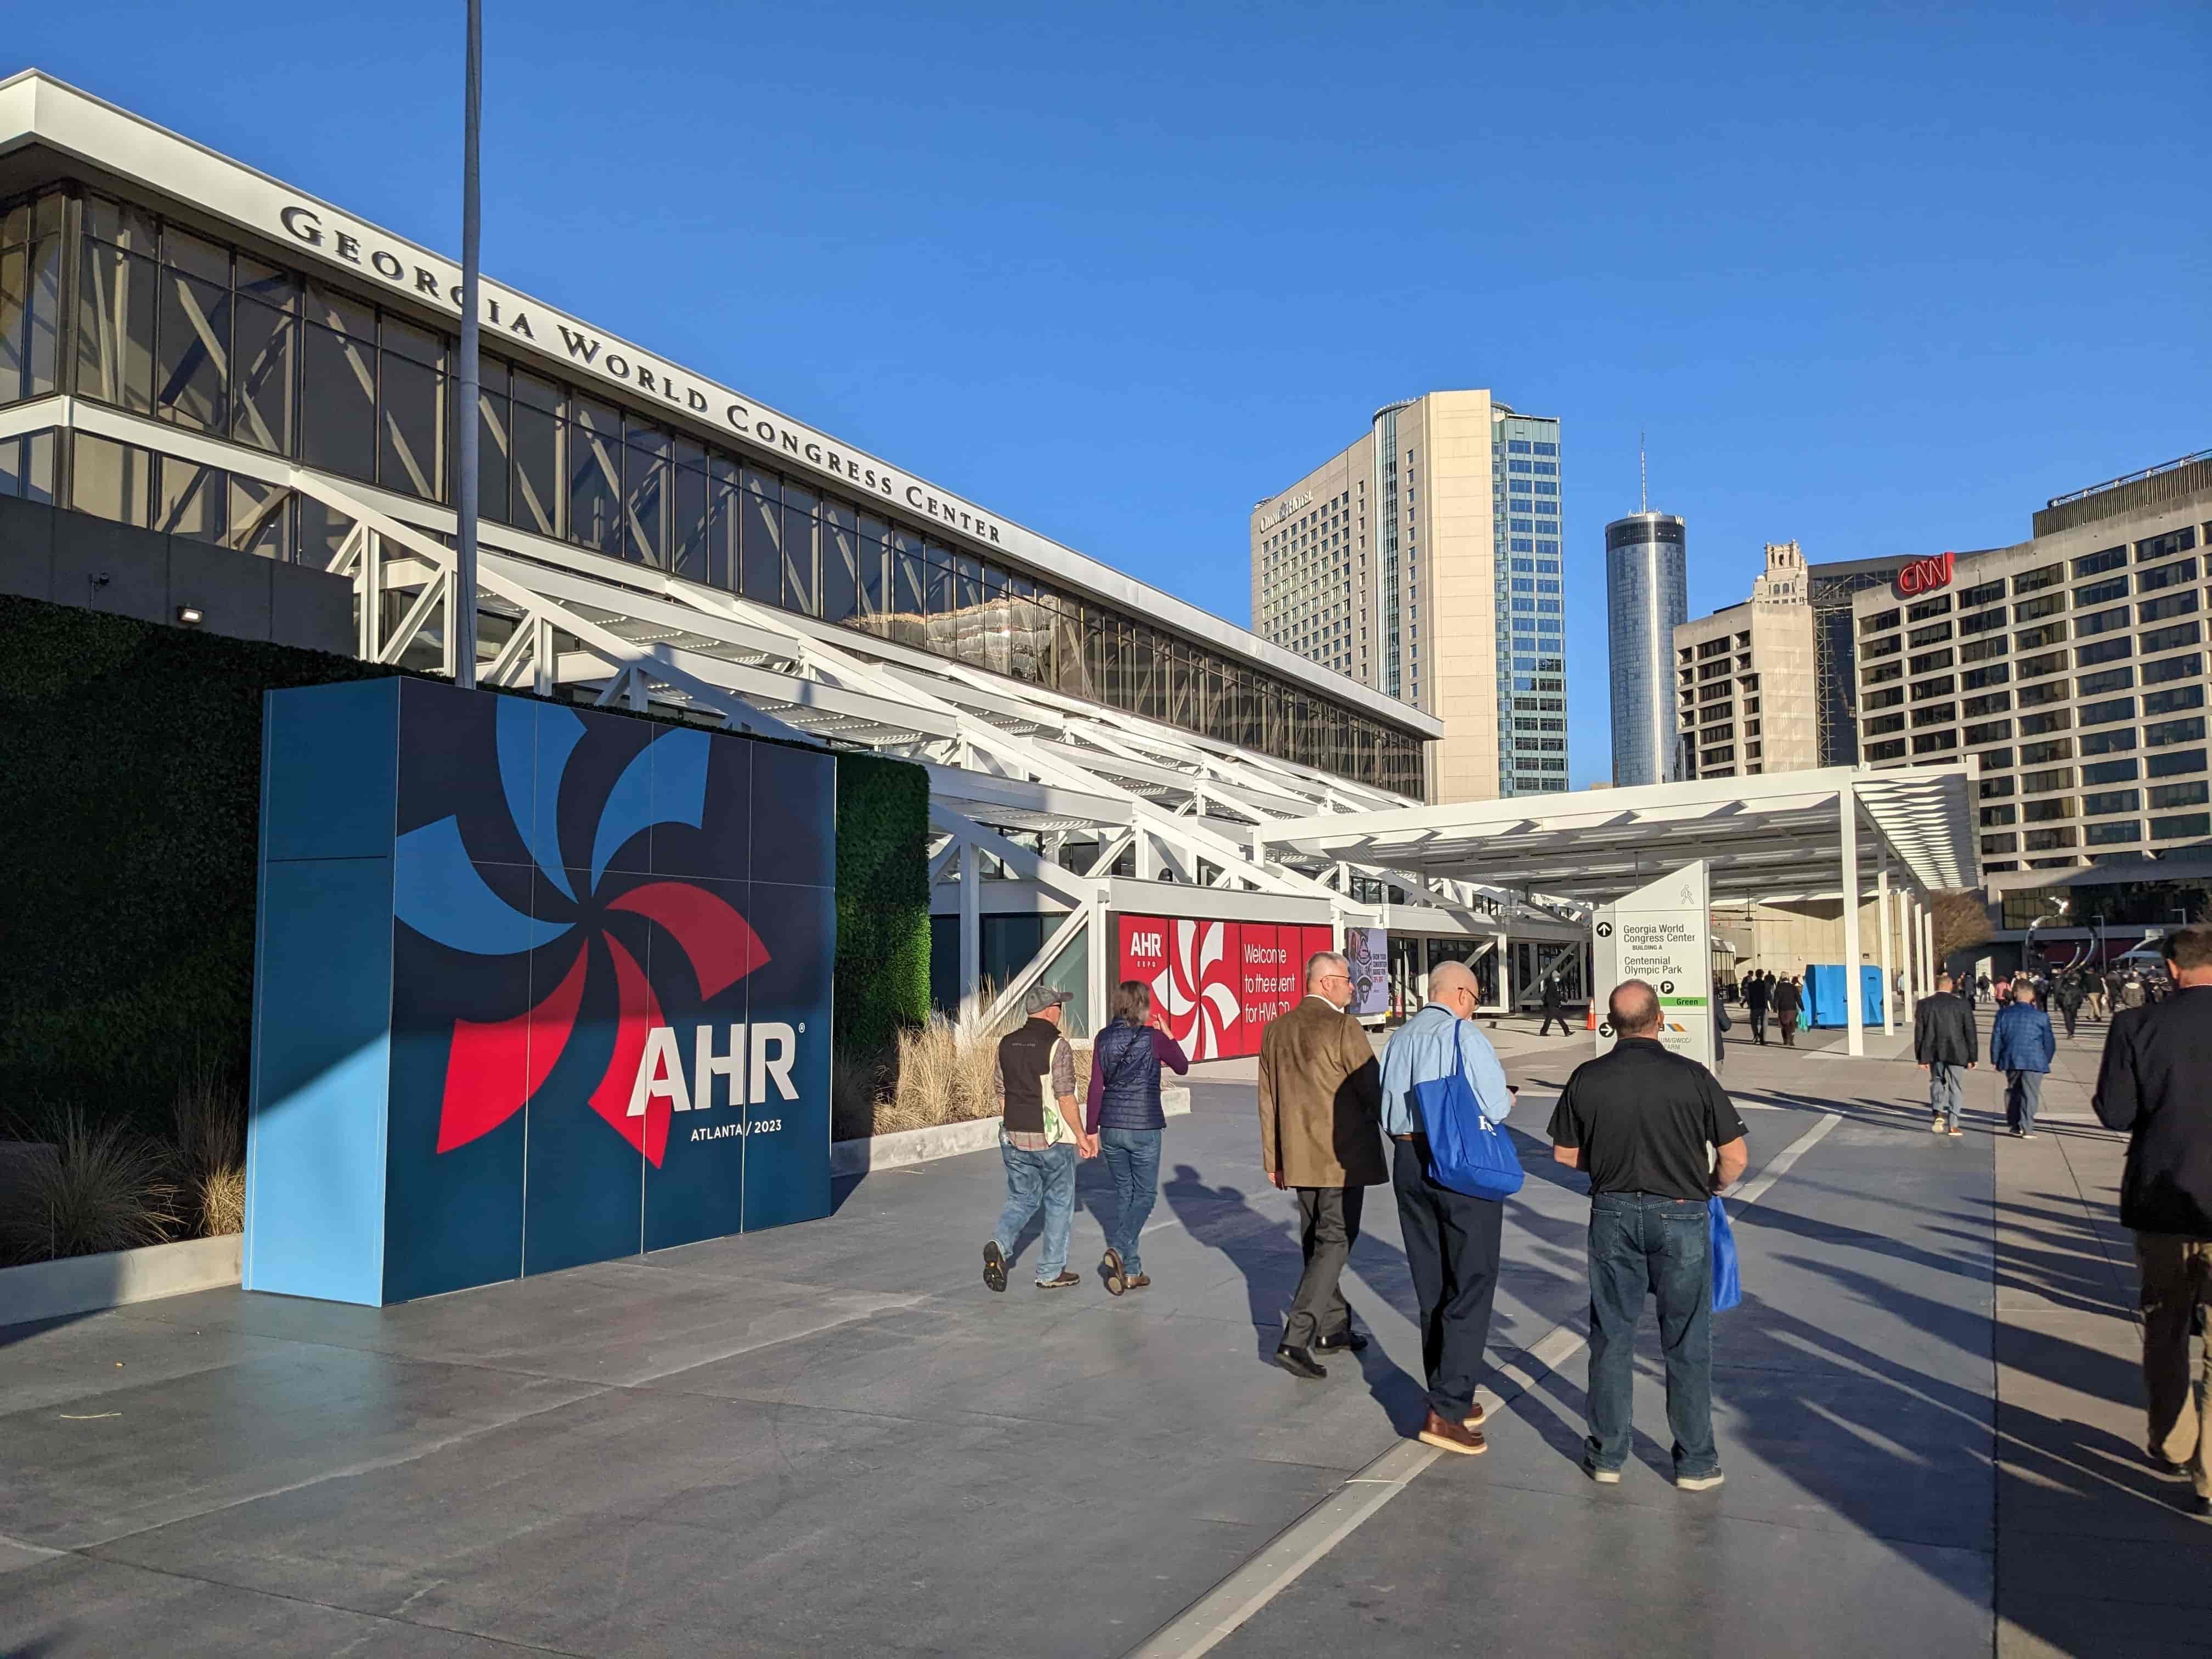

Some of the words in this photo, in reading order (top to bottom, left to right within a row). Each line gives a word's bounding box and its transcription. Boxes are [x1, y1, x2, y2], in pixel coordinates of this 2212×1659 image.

[557, 324, 708, 413] WORLD
[726, 405, 893, 494] CONGRESS
[906, 486, 1001, 544] CENTER
[1897, 552, 1954, 596] CNN
[1623, 925, 1657, 935] Georgia
[1658, 924, 1684, 933] World
[1624, 934, 1664, 944] Congress
[1667, 934, 1695, 942] Center
[1130, 932, 1162, 957] AHR
[1244, 944, 1286, 964] Welcome
[1624, 956, 1671, 965] Centennial
[1624, 966, 1660, 976] Olympic
[1662, 966, 1683, 974] Park
[1245, 974, 1254, 993] to
[1255, 973, 1269, 992] the
[1271, 973, 1295, 992] event
[1245, 1003, 1257, 1023] for
[691, 1123, 743, 1142] ATLANTA
[754, 1119, 782, 1134] 2023
